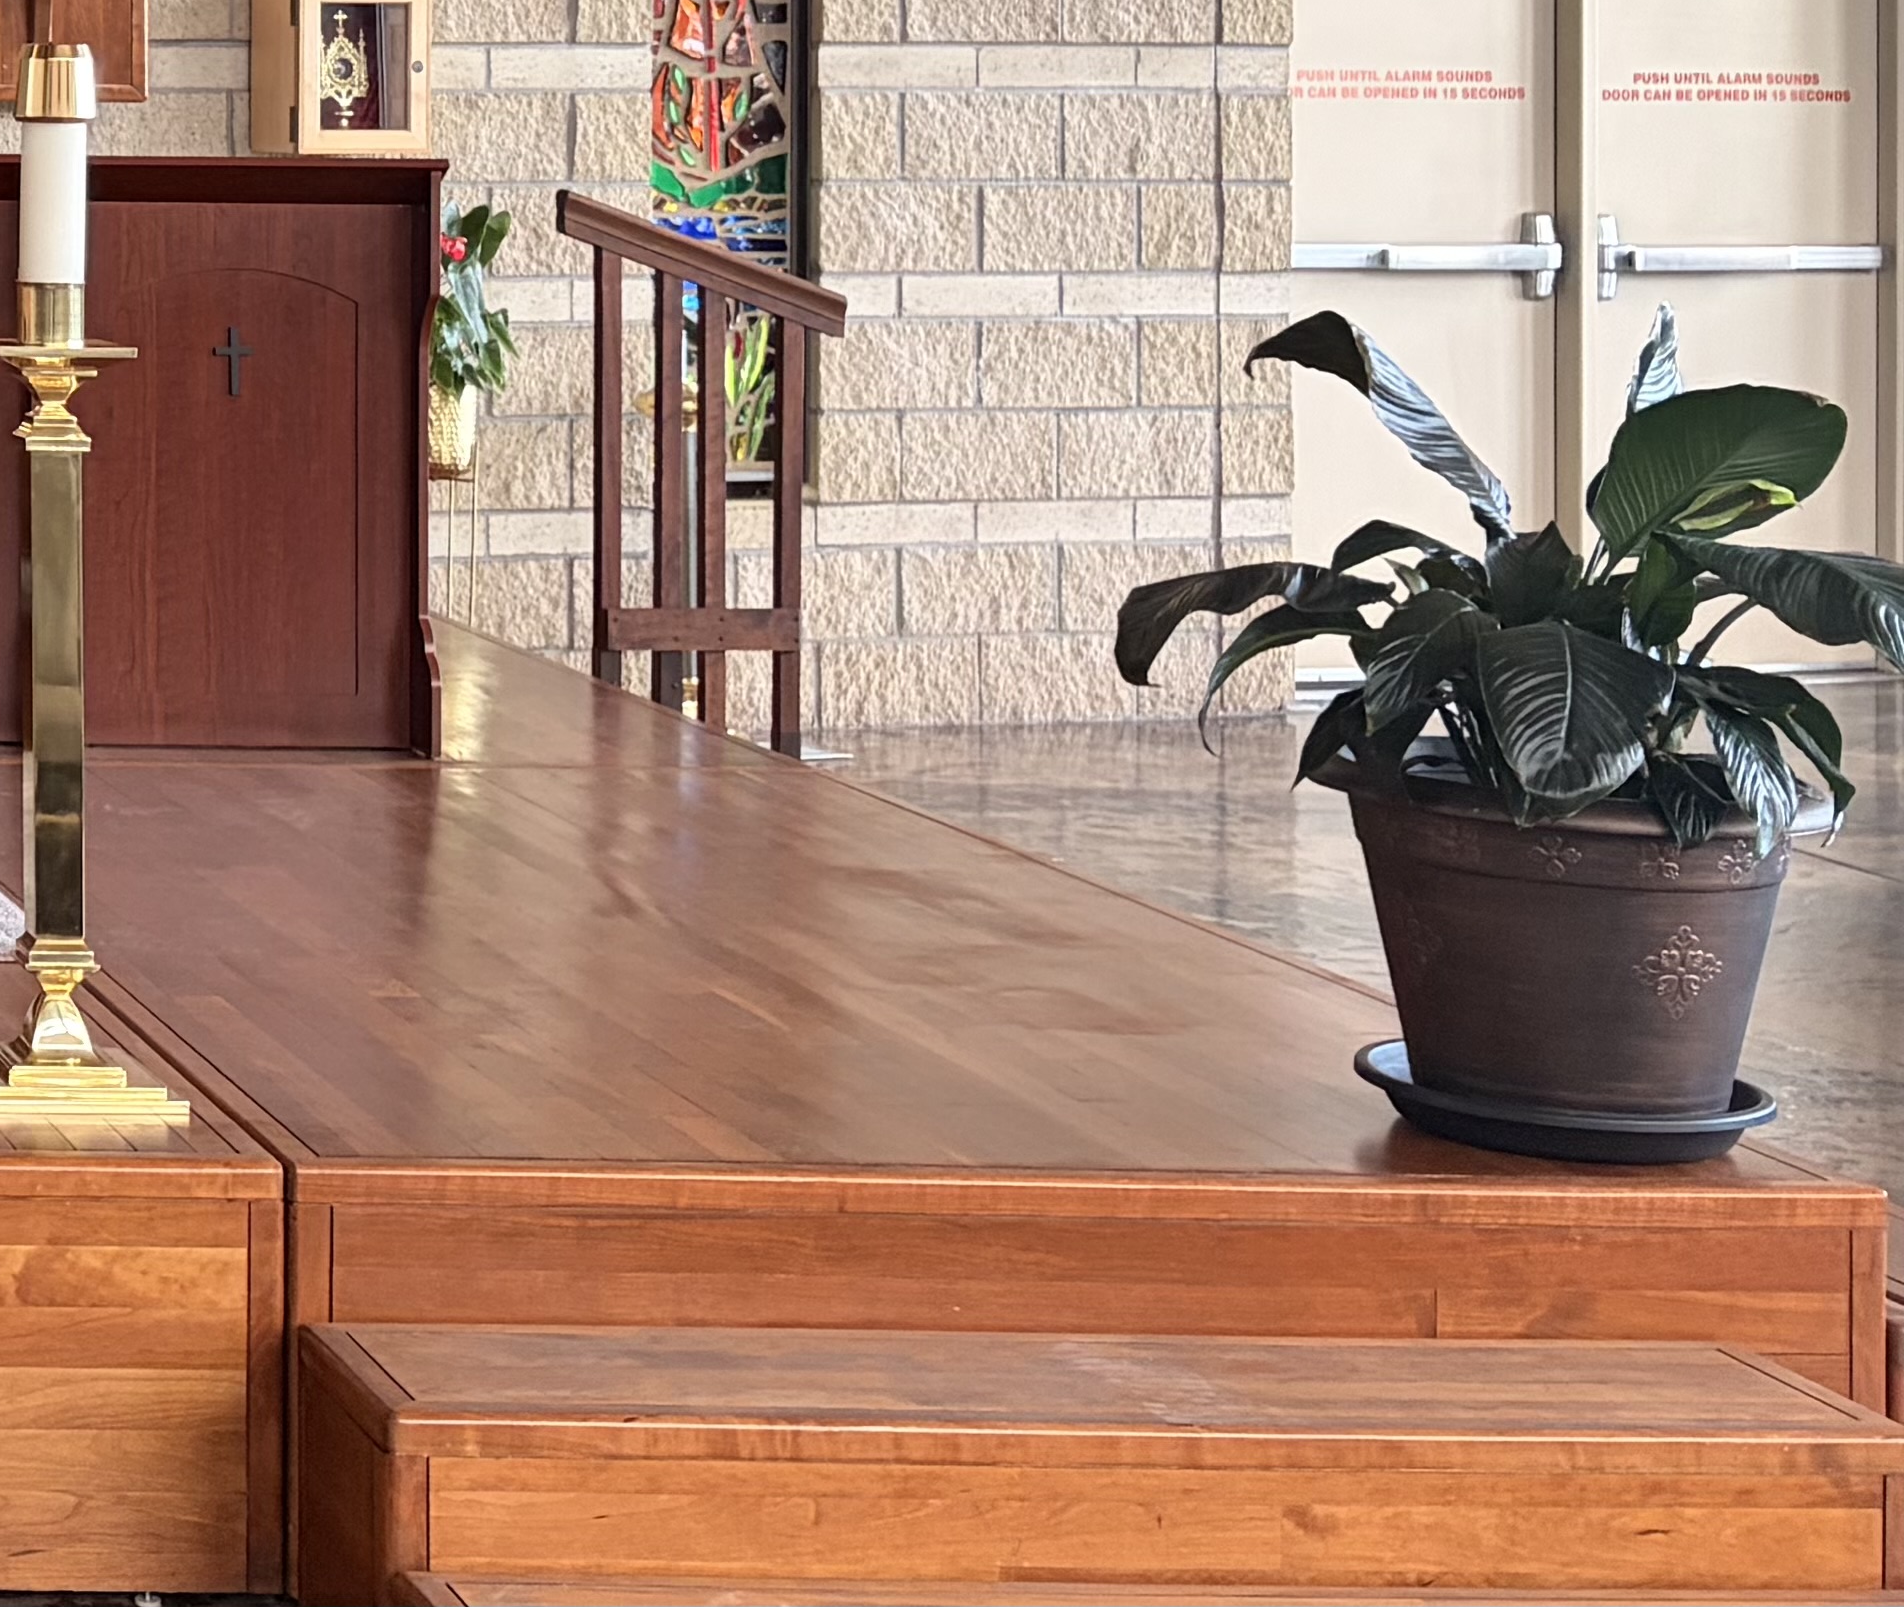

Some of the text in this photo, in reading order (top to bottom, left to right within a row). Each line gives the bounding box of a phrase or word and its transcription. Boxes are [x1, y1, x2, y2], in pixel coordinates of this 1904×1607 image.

[1297, 70, 1492, 82] PUSH UNTIL ALARM SOUNDS
[1633, 72, 1820, 85] PUSH UNTIL ALARM SOUNDS
[1308, 87, 1336, 98] CAN
[1341, 87, 1359, 98] BE
[1363, 87, 1419, 98] OPENED
[1423, 87, 1437, 99] IN
[1443, 87, 1458, 99] 15
[1461, 87, 1526, 99] SECONDS
[1602, 89, 1852, 102] DOOR CAN BE OPENED IN 15 SECONDS
